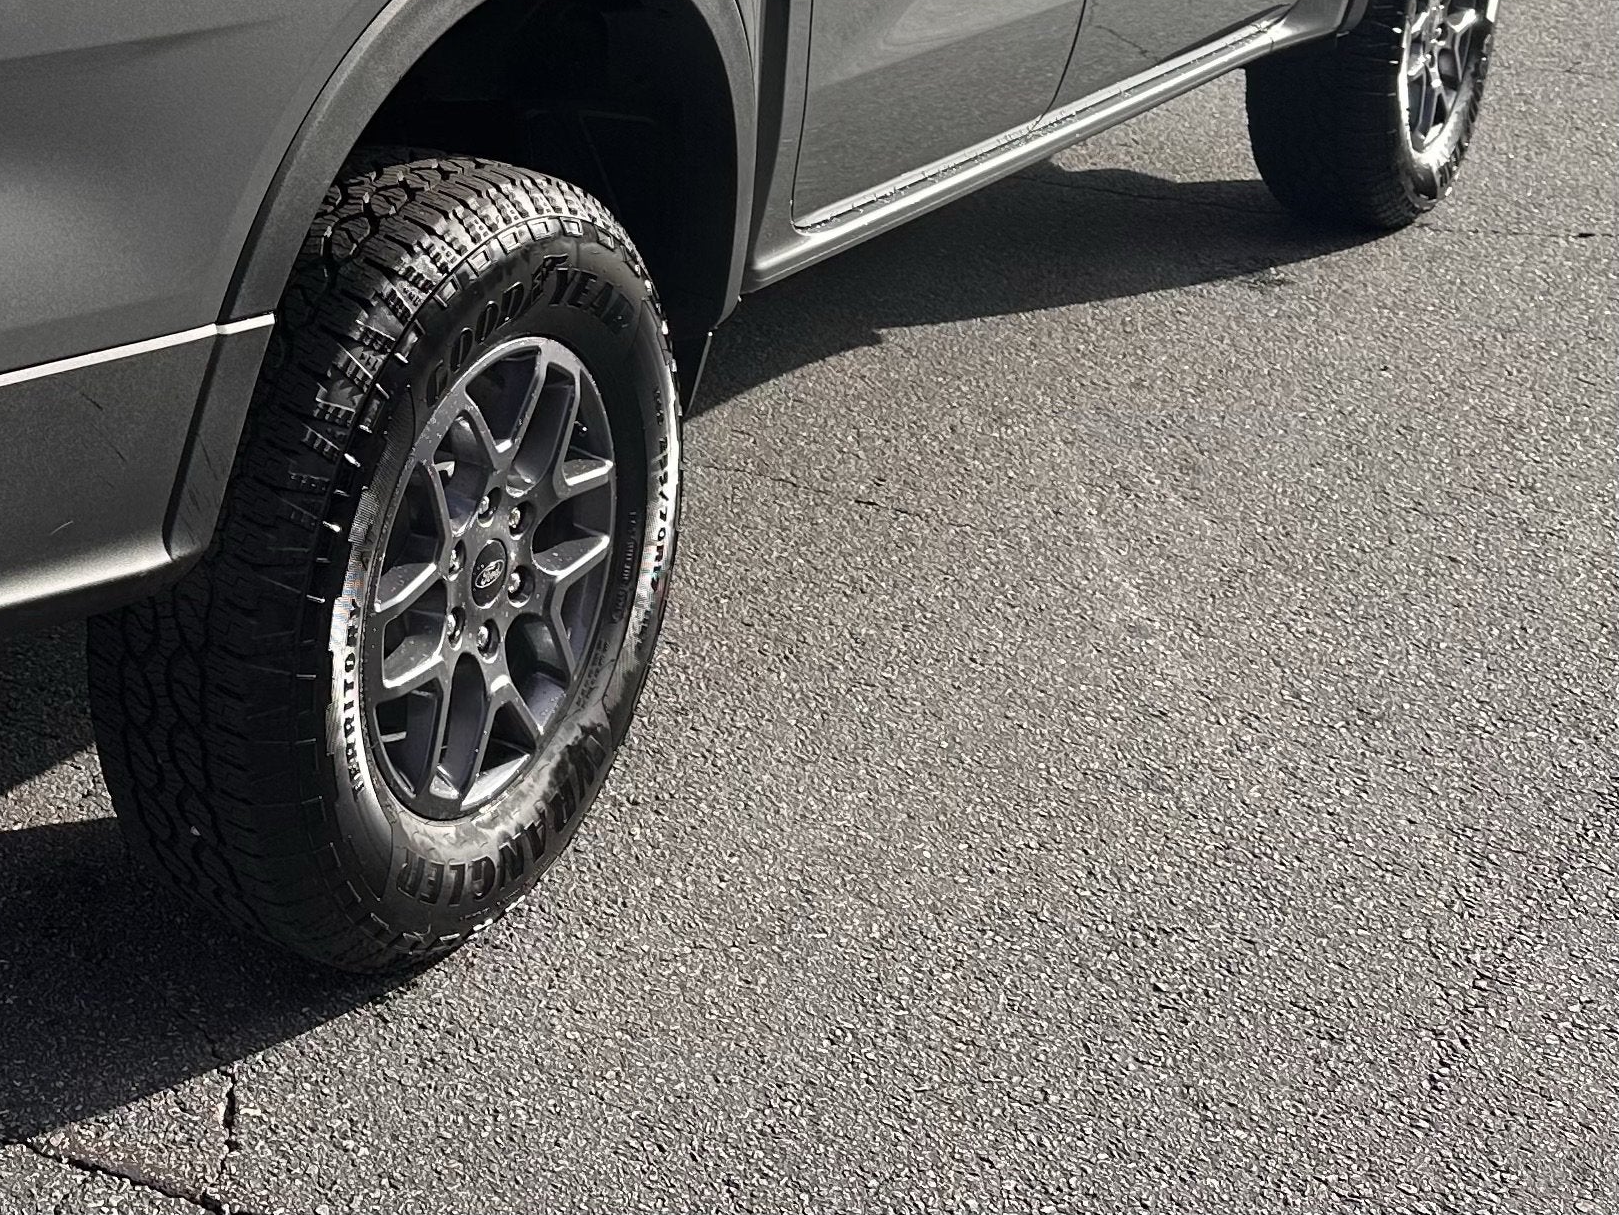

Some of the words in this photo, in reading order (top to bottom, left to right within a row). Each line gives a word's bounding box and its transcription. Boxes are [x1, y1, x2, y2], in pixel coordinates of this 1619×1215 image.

[425, 253, 635, 408] GOODYEAR
[343, 597, 366, 803] TERRITORY
[396, 730, 609, 907] WRANGLER
